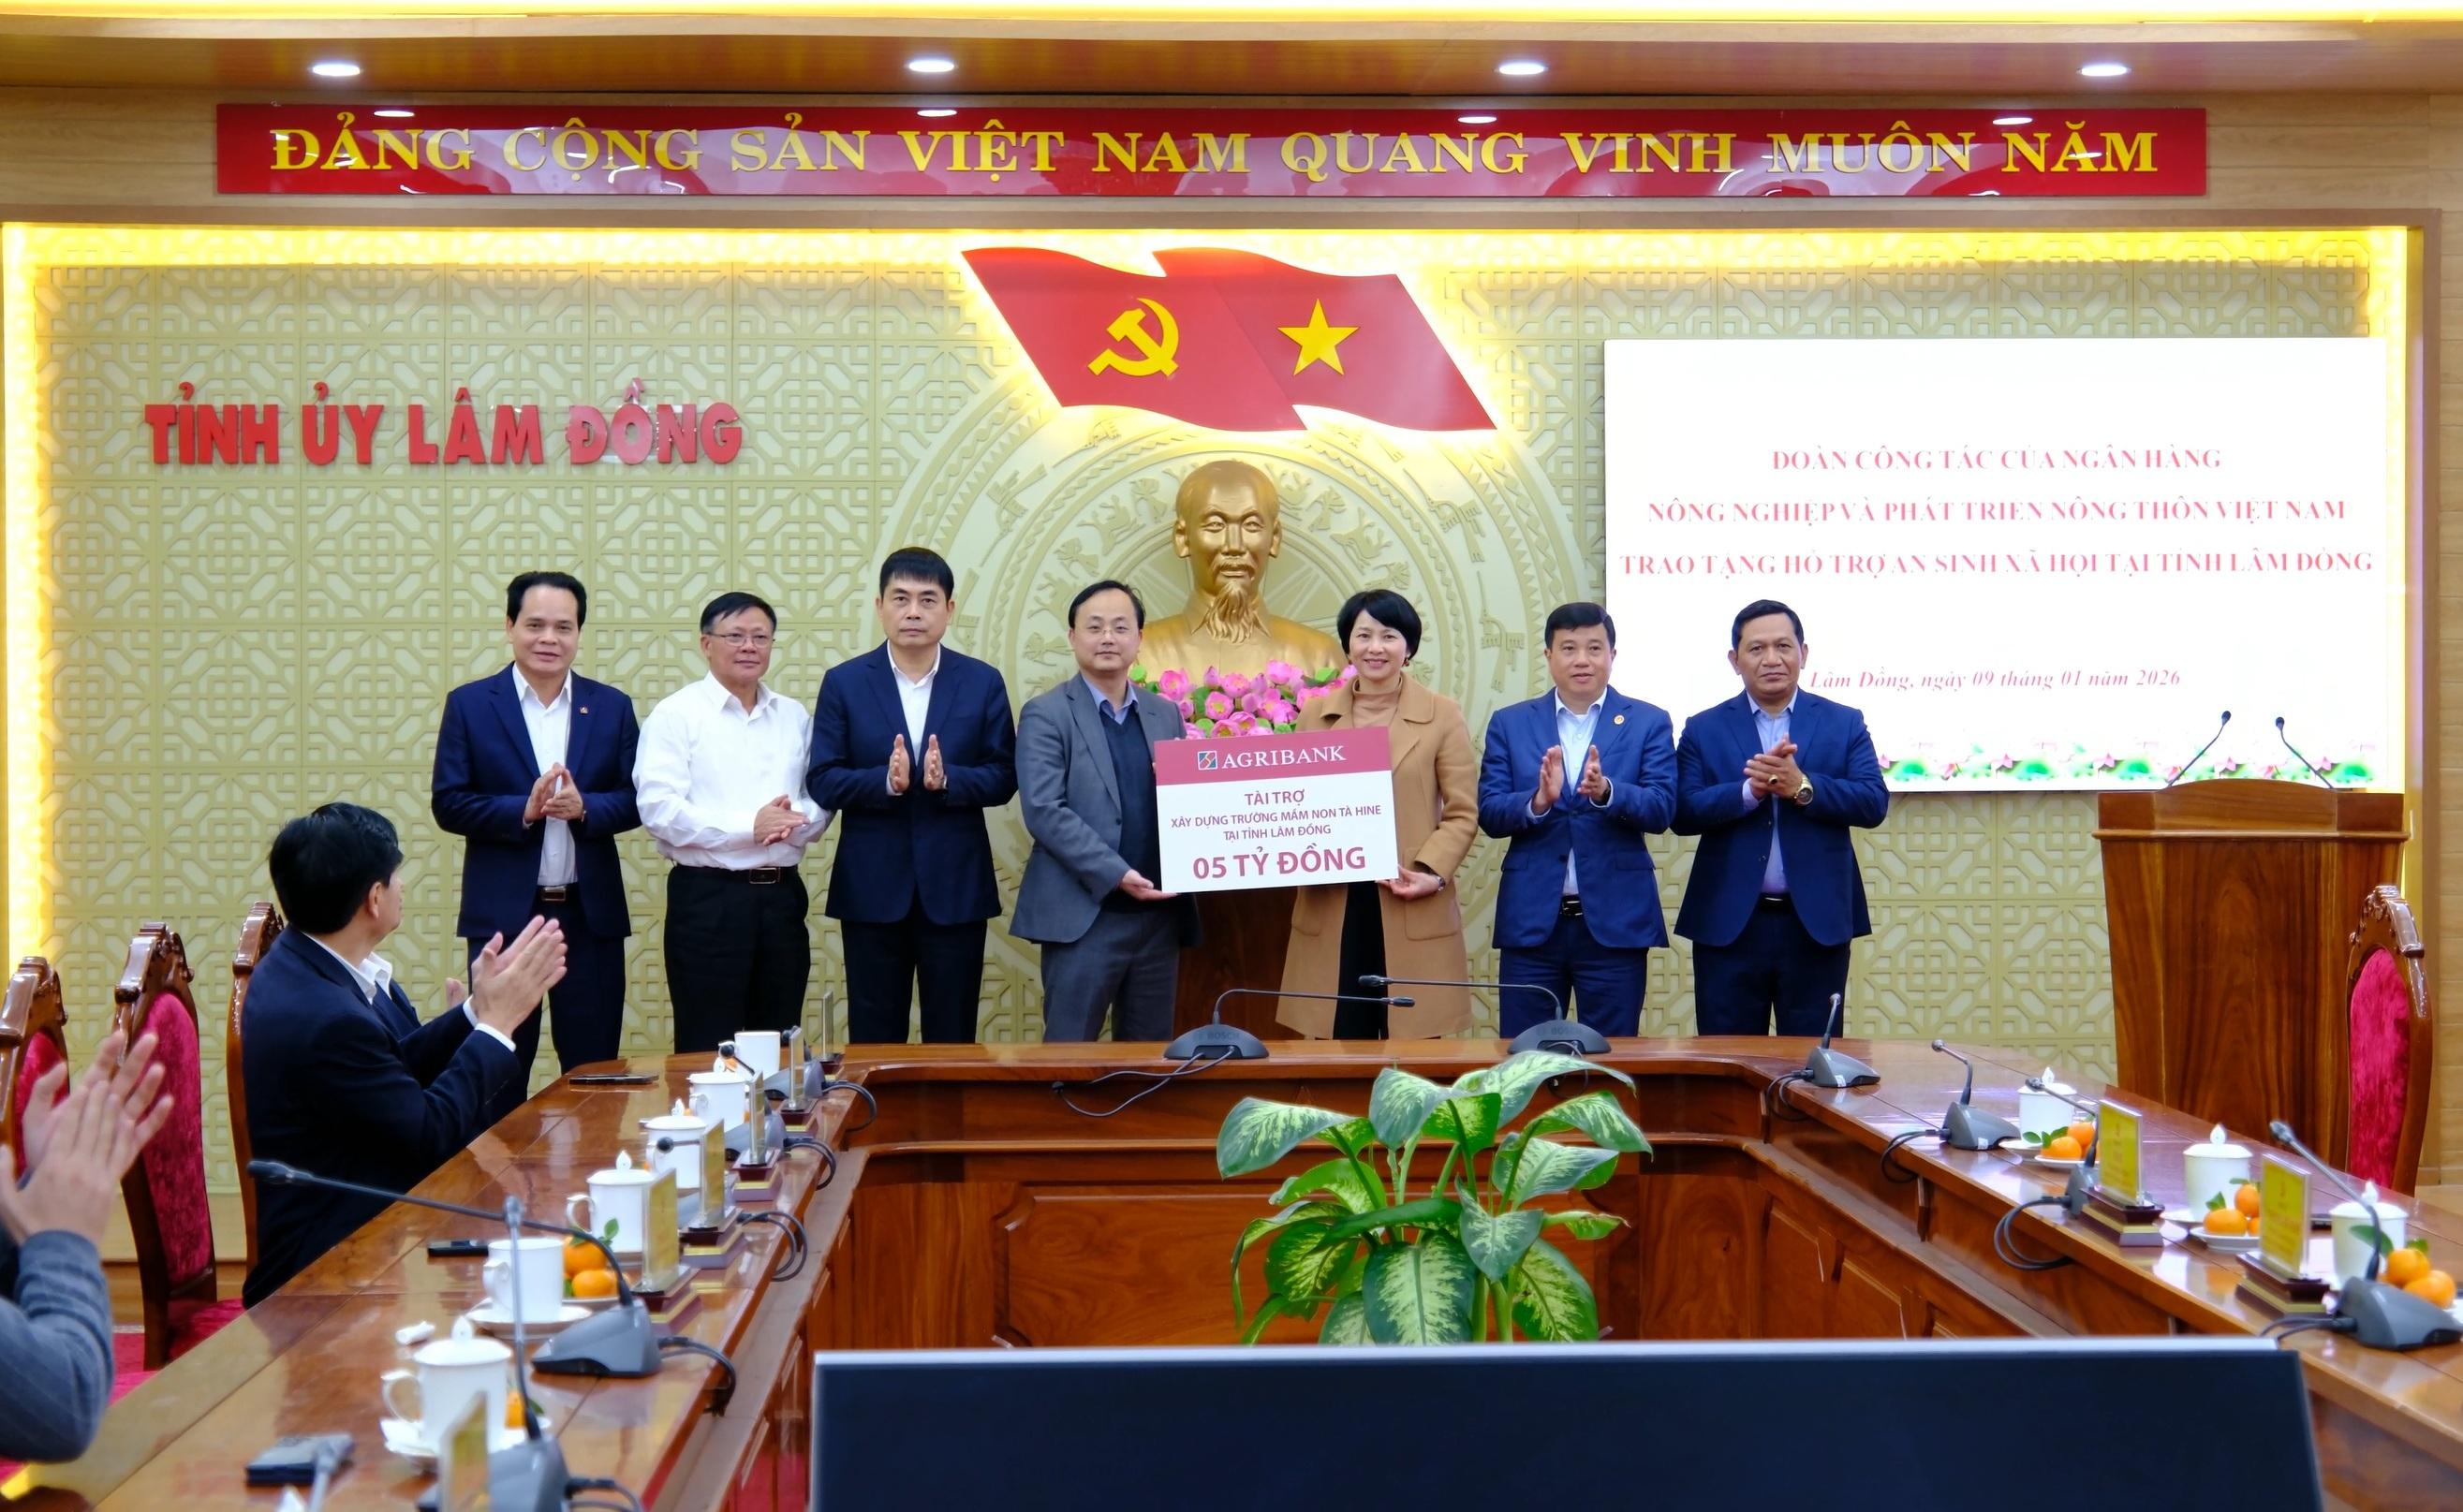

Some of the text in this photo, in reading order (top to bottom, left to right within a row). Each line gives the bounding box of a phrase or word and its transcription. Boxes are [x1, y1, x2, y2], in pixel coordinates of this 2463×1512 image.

[271, 112, 2158, 183] ĐẢNG CỘNG SẢN VIỆT NAM QUANG VINH MUÔN NĂM
[146, 382, 280, 464] TỈNH
[302, 382, 384, 464] ỦY
[408, 388, 543, 464] LÂM
[1855, 446, 1931, 469] CÔNG
[1939, 445, 1992, 468] TÁC
[2063, 445, 2135, 468] NGÂN
[2146, 444, 2220, 468] HÀNG
[1649, 497, 1723, 521] NÔNG
[1841, 497, 1874, 521] VÀ
[1885, 497, 1954, 521] PHÁT
[2052, 496, 2126, 520] NÔNG
[2134, 496, 2207, 520] THÔN
[2286, 501, 2344, 519] NAM
[1620, 556, 1694, 574] TRAO
[1893, 555, 1925, 573] AN
[1936, 554, 1996, 572] SINH
[2006, 550, 2040, 572] XÃ
[2105, 554, 2149, 577] TẠI
[2231, 548, 2287, 571] LÂM
[1973, 671, 1994, 685] 09
[2001, 671, 2053, 689] tháng
[2061, 670, 2081, 685] 01
[2136, 669, 2179, 685] 2026
[1222, 746, 1346, 769] AGRIBANK
[1244, 789, 1305, 806] TÀI TRỢ
[1312, 809, 1336, 819] NON
[1356, 805, 1381, 815] HINE
[1223, 830, 1239, 843] TẠI
[1193, 843, 1365, 879] 05 TỶ ĐỒNG
